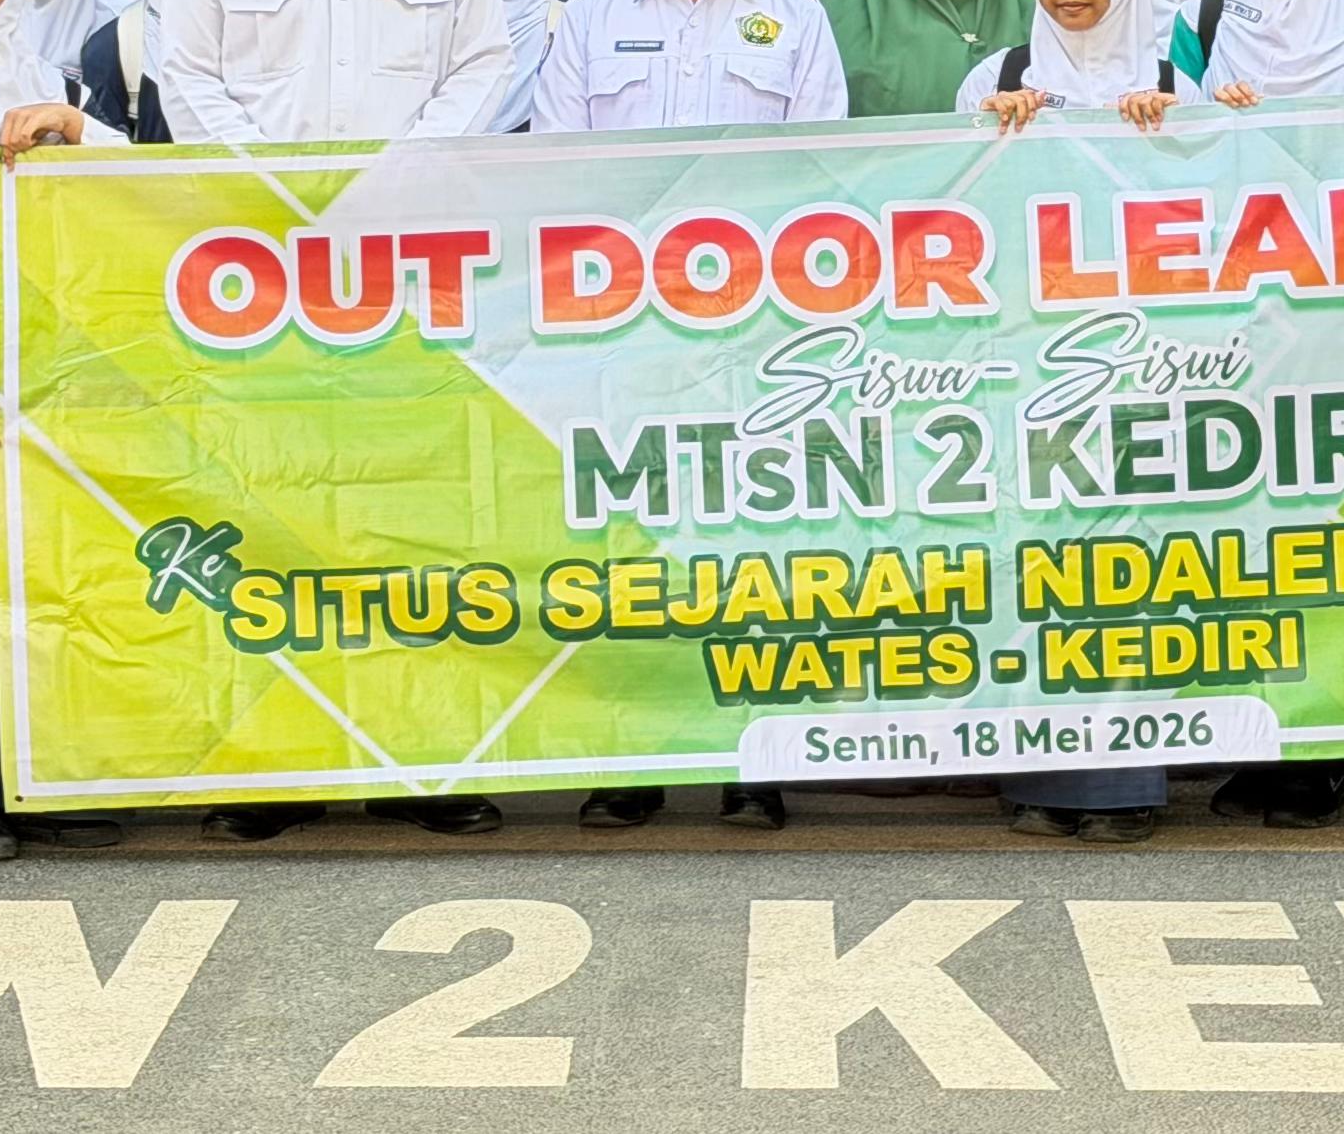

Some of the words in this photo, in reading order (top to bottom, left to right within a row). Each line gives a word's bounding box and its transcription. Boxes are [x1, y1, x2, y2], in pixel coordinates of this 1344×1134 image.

[174, 229, 491, 339] OUT
[538, 208, 991, 323] DOOR
[1023, 311, 1249, 423] Siswi
[571, 415, 886, 520] MTsN
[924, 413, 988, 505] 2
[141, 522, 229, 603] Ke
[229, 568, 514, 641] SITUS
[545, 548, 987, 630] SEJARAH
[709, 632, 975, 694] WATES
[1043, 617, 1300, 681] KEDIRI
[805, 722, 941, 766] Senin,
[952, 721, 1000, 758] 18
[1014, 716, 1093, 757] Mei
[1106, 709, 1214, 751] 2026
[313, 898, 594, 1090] 2
